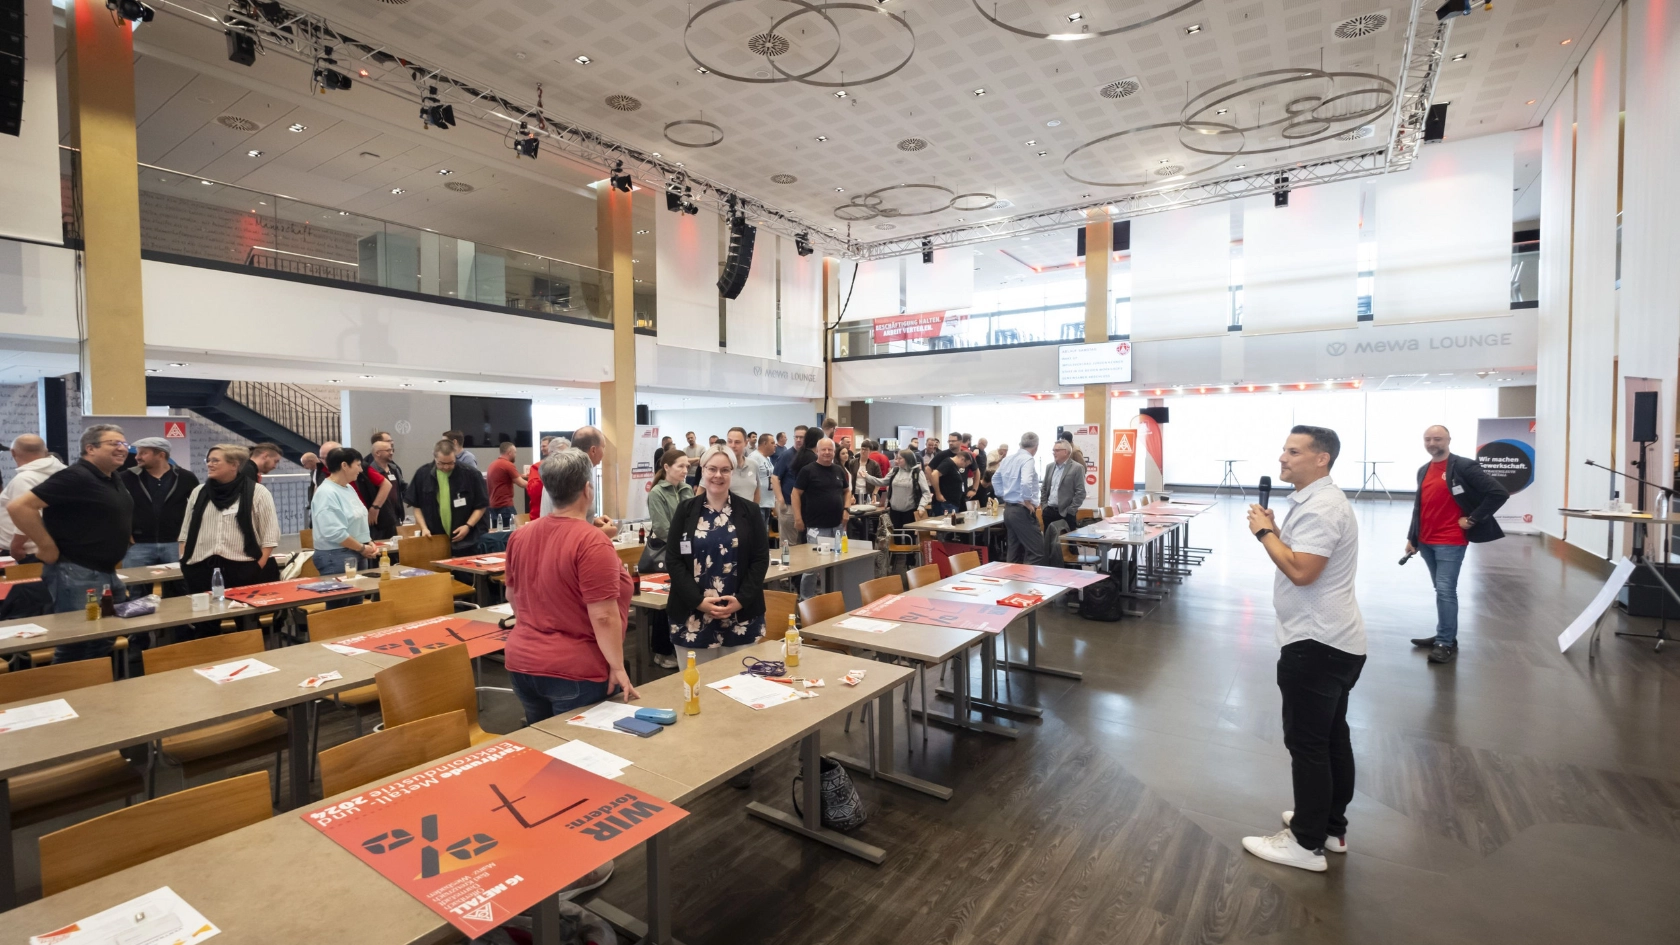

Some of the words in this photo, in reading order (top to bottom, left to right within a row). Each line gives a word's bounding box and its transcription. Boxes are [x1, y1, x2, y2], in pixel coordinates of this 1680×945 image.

[875, 318, 918, 331] BESCHÄFTIGUNG
[918, 316, 942, 325] HALTEN.
[883, 327, 903, 337] ARBEIT
[902, 324, 934, 335] VERTEILEN.
[1429, 332, 1512, 350] LOUNGE
[790, 372, 817, 382] LOUNGE
[369, 742, 514, 797] Elektroindustrie
[440, 744, 526, 779] Tarifrunde
[370, 777, 440, 805] Metall-
[310, 796, 369, 820] 2024
[317, 806, 361, 827] und
[489, 783, 590, 829] 7
[565, 793, 638, 830] fordern:
[579, 800, 665, 842] WIR
[361, 813, 499, 879] %
[473, 862, 497, 875] Mainz
[473, 871, 490, 882] Bad
[504, 874, 525, 887] IG
[426, 875, 472, 899] Wiesbaden
[432, 880, 475, 902] Kreuznach
[437, 883, 481, 907] Darmstadt
[449, 883, 508, 915] METALL
